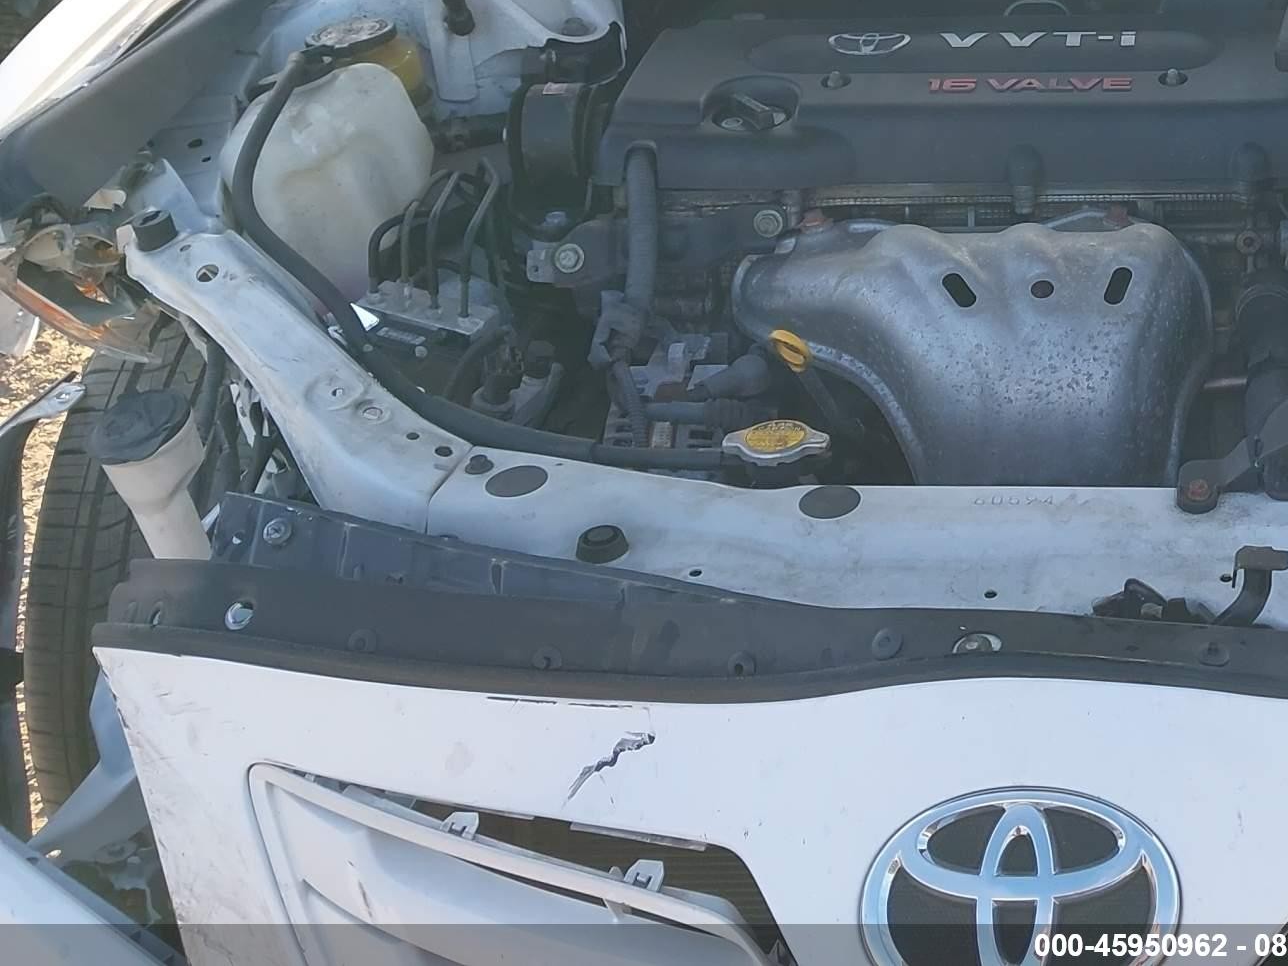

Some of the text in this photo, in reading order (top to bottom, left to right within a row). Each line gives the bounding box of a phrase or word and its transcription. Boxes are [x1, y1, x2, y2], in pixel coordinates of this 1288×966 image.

[939, 31, 1137, 48] VVT-i
[929, 77, 1133, 92] 16 VALVE
